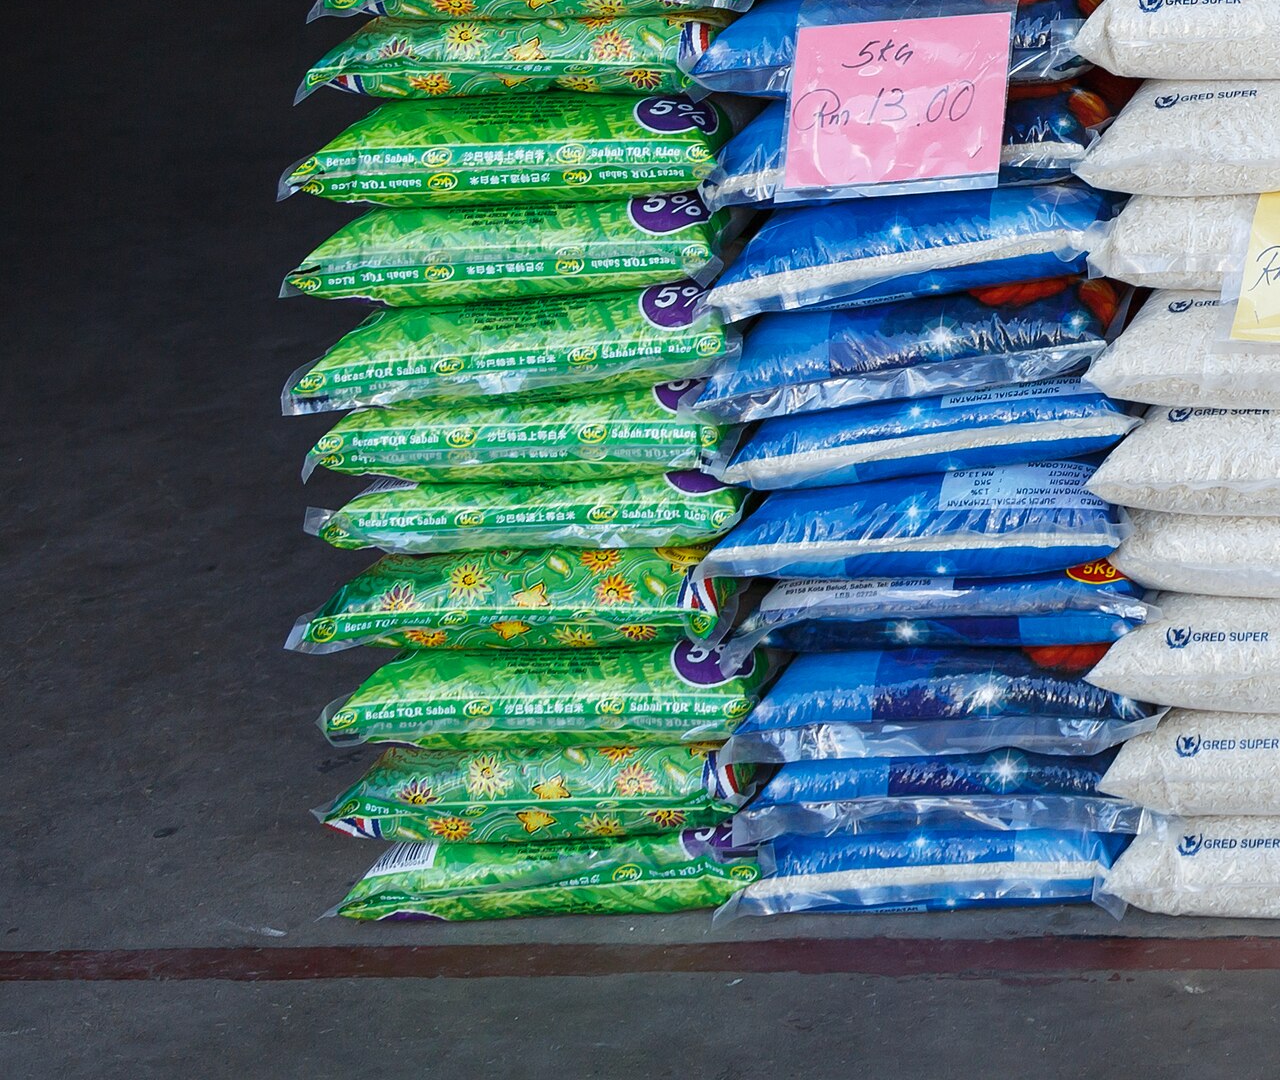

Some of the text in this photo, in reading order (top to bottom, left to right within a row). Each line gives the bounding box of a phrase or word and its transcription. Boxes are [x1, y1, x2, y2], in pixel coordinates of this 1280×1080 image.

[648, 98, 707, 127] 5%
[1082, 562, 1118, 580] 5Kg
[397, 707, 424, 718] TQR
[426, 704, 456, 716] Sabah
[1203, 837, 1280, 850] GRED SUPER
